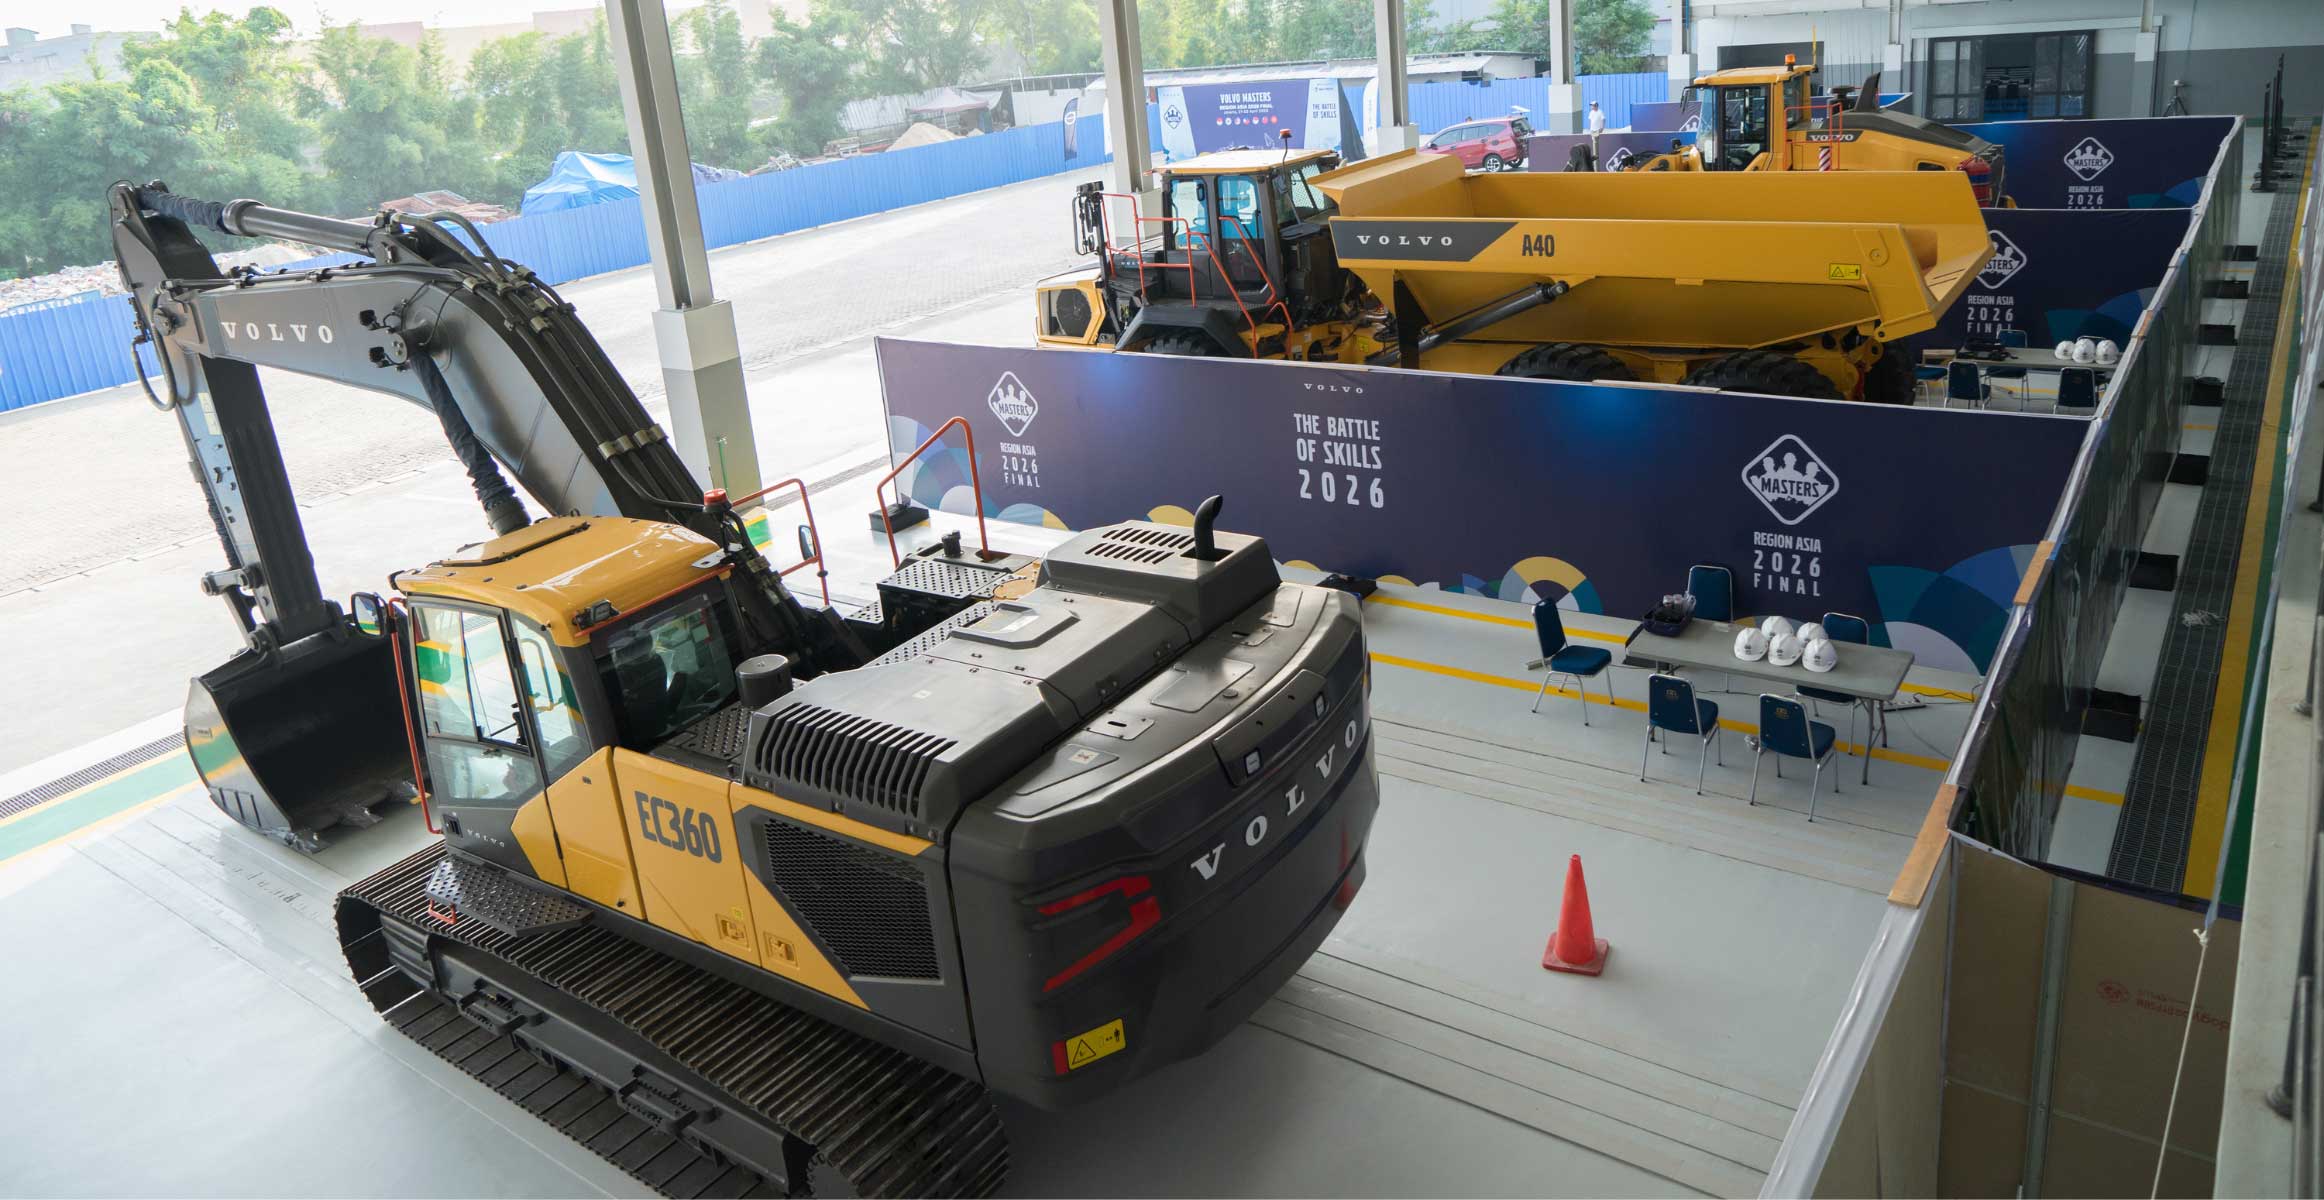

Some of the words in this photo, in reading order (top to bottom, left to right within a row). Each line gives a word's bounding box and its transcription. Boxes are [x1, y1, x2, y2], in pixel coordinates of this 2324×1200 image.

[1220, 93, 1240, 103] VOLVO
[1242, 92, 1272, 102] MASTERS
[1810, 134, 1854, 142] VOVO
[2068, 194, 2104, 205] 2026
[1356, 235, 1453, 246] VOLVO
[1521, 233, 1555, 258] A40
[1967, 295, 1995, 304] REGION
[1996, 296, 2014, 306] ASIA
[1967, 307, 2014, 322] 2026
[220, 321, 334, 344] VOLVO
[1303, 383, 1363, 394] VOLVO
[998, 403, 1030, 416] MASTERS
[1293, 413, 1320, 435] THE
[1327, 416, 1380, 441] BATTLE
[1000, 442, 1021, 455] REGION
[1022, 444, 1036, 456] ASIA
[1296, 438, 1316, 462] OF
[1322, 441, 1382, 470] SKILLS
[1002, 455, 1038, 474] 2026
[1004, 472, 1040, 488] FINAL
[1298, 468, 1384, 509] 2026
[1760, 477, 1820, 498] MASTERS
[1753, 531, 1793, 549] REGION
[1795, 536, 1822, 553] ASIA
[1753, 550, 1821, 578] 2026
[1753, 572, 1821, 597] FINAL
[1190, 720, 1357, 881] VOLVO
[634, 790, 722, 864] EC360
